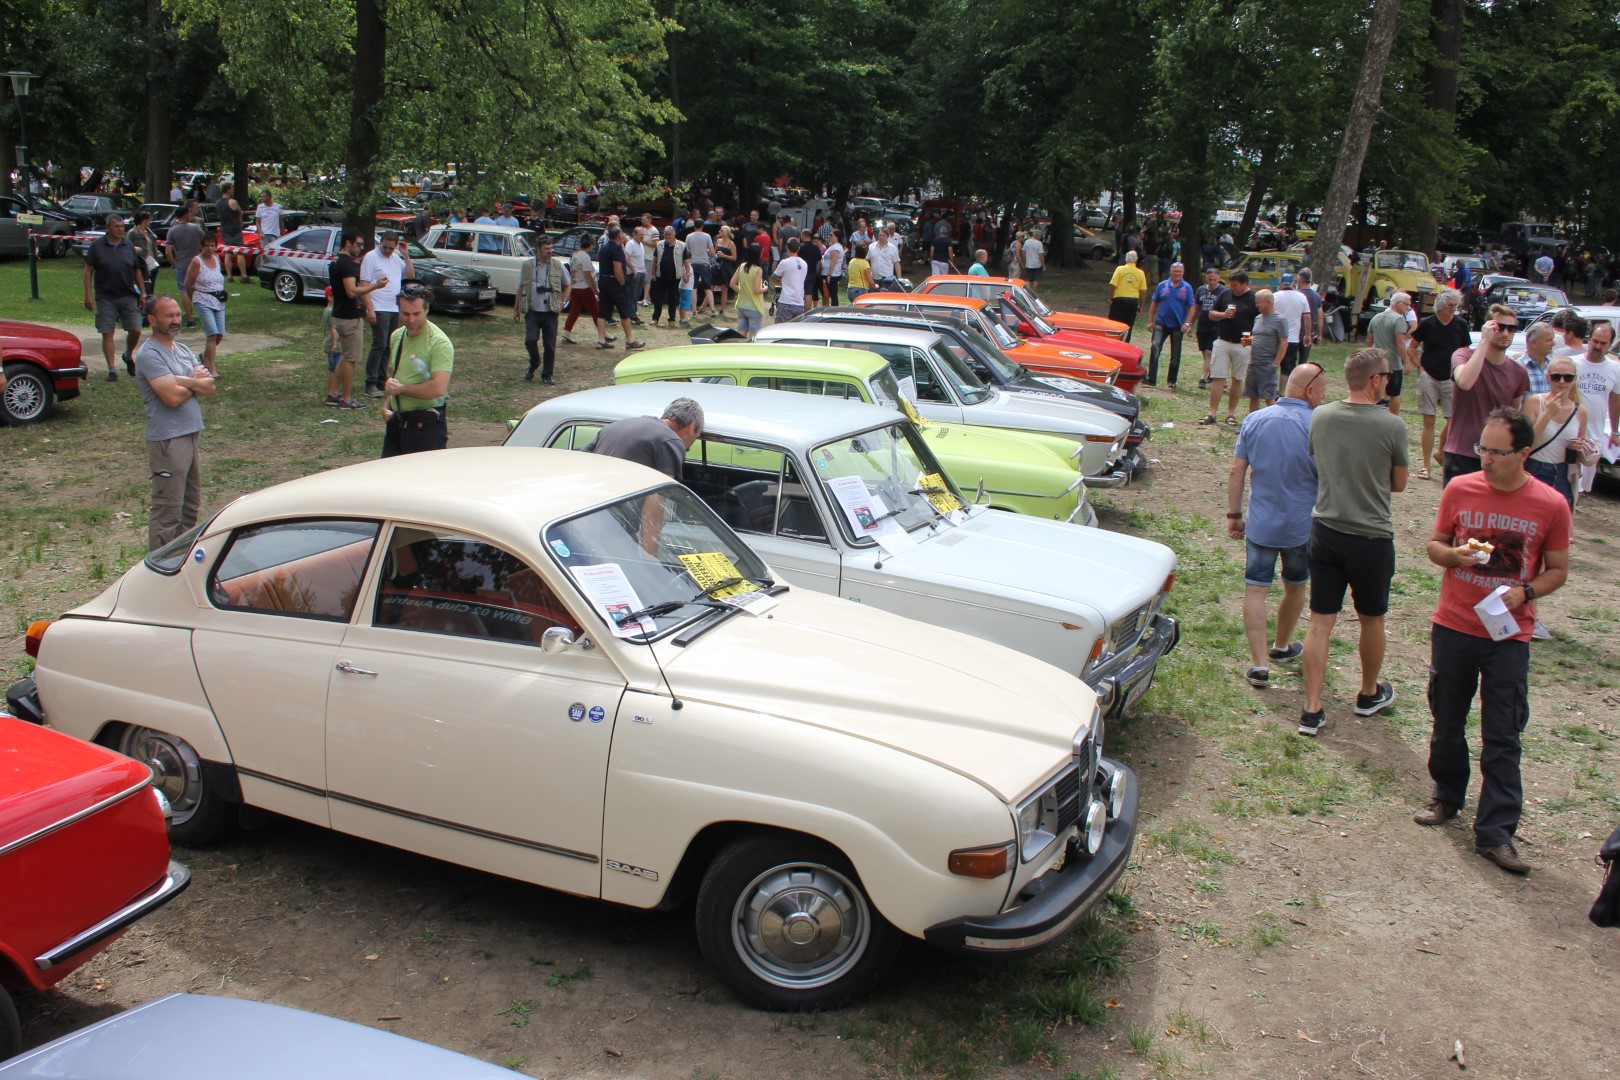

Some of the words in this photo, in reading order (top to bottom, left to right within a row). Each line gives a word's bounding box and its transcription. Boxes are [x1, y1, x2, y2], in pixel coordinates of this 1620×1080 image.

[1592, 373, 1607, 383] YORK
[1577, 383, 1607, 392] HILFIGER
[1459, 511, 1484, 529] OLD
[1487, 513, 1538, 536] RIDERS
[1454, 568, 1473, 582] SAN
[606, 859, 659, 882] SAAB
